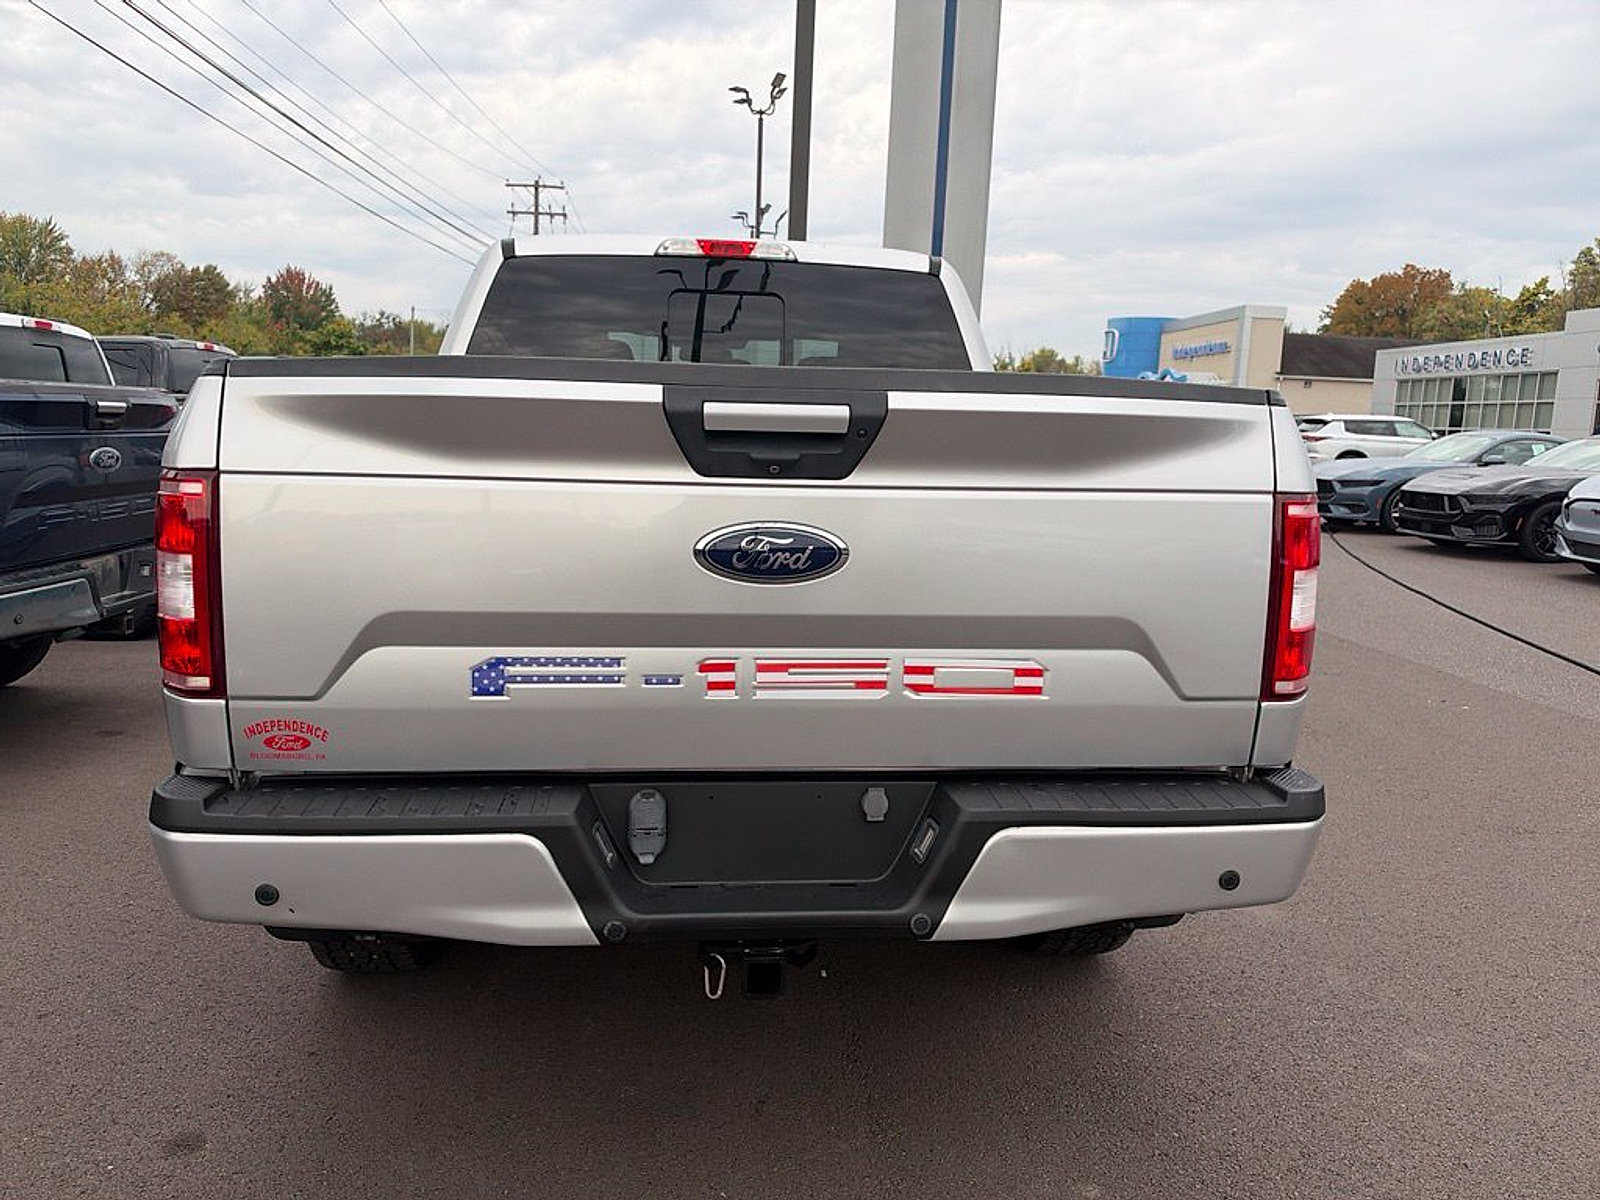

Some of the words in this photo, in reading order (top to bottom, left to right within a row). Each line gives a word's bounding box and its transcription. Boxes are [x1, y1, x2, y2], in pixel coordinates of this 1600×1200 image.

[1394, 347, 1533, 374] INDEPENDENCE
[732, 535, 812, 570] Ford
[470, 655, 1048, 701] F-150
[243, 719, 329, 743] INDEPENDENCE
[272, 735, 303, 750] Ford
